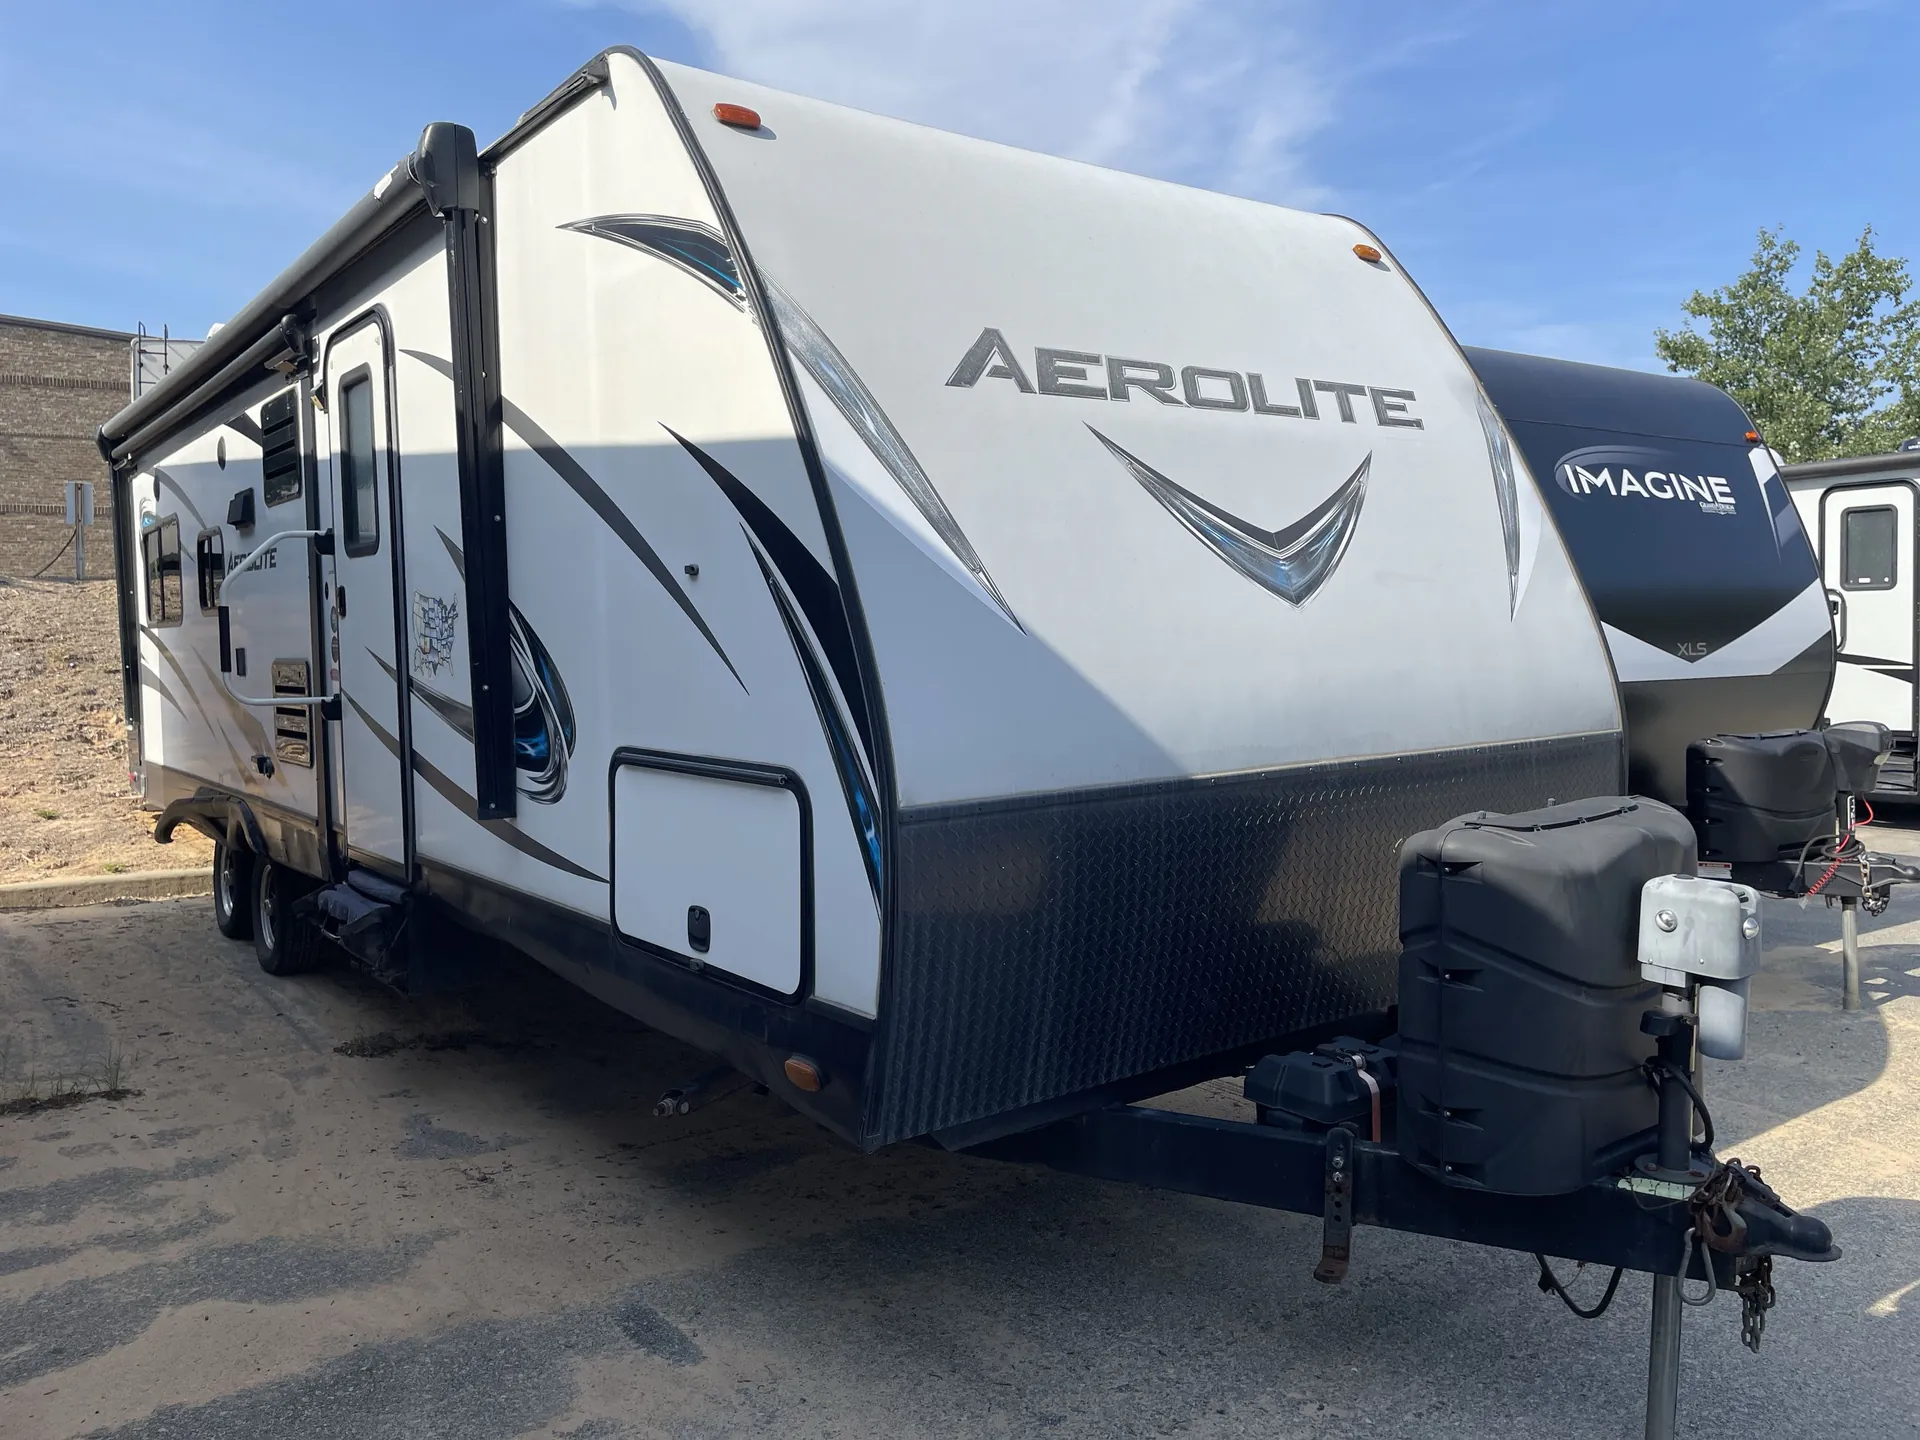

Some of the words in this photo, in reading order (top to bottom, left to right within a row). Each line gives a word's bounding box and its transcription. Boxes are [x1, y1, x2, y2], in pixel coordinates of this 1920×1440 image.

[944, 326, 1425, 431] AEROLITE
[1564, 464, 1736, 504] IMAGINE
[1677, 642, 1707, 656] XLS
